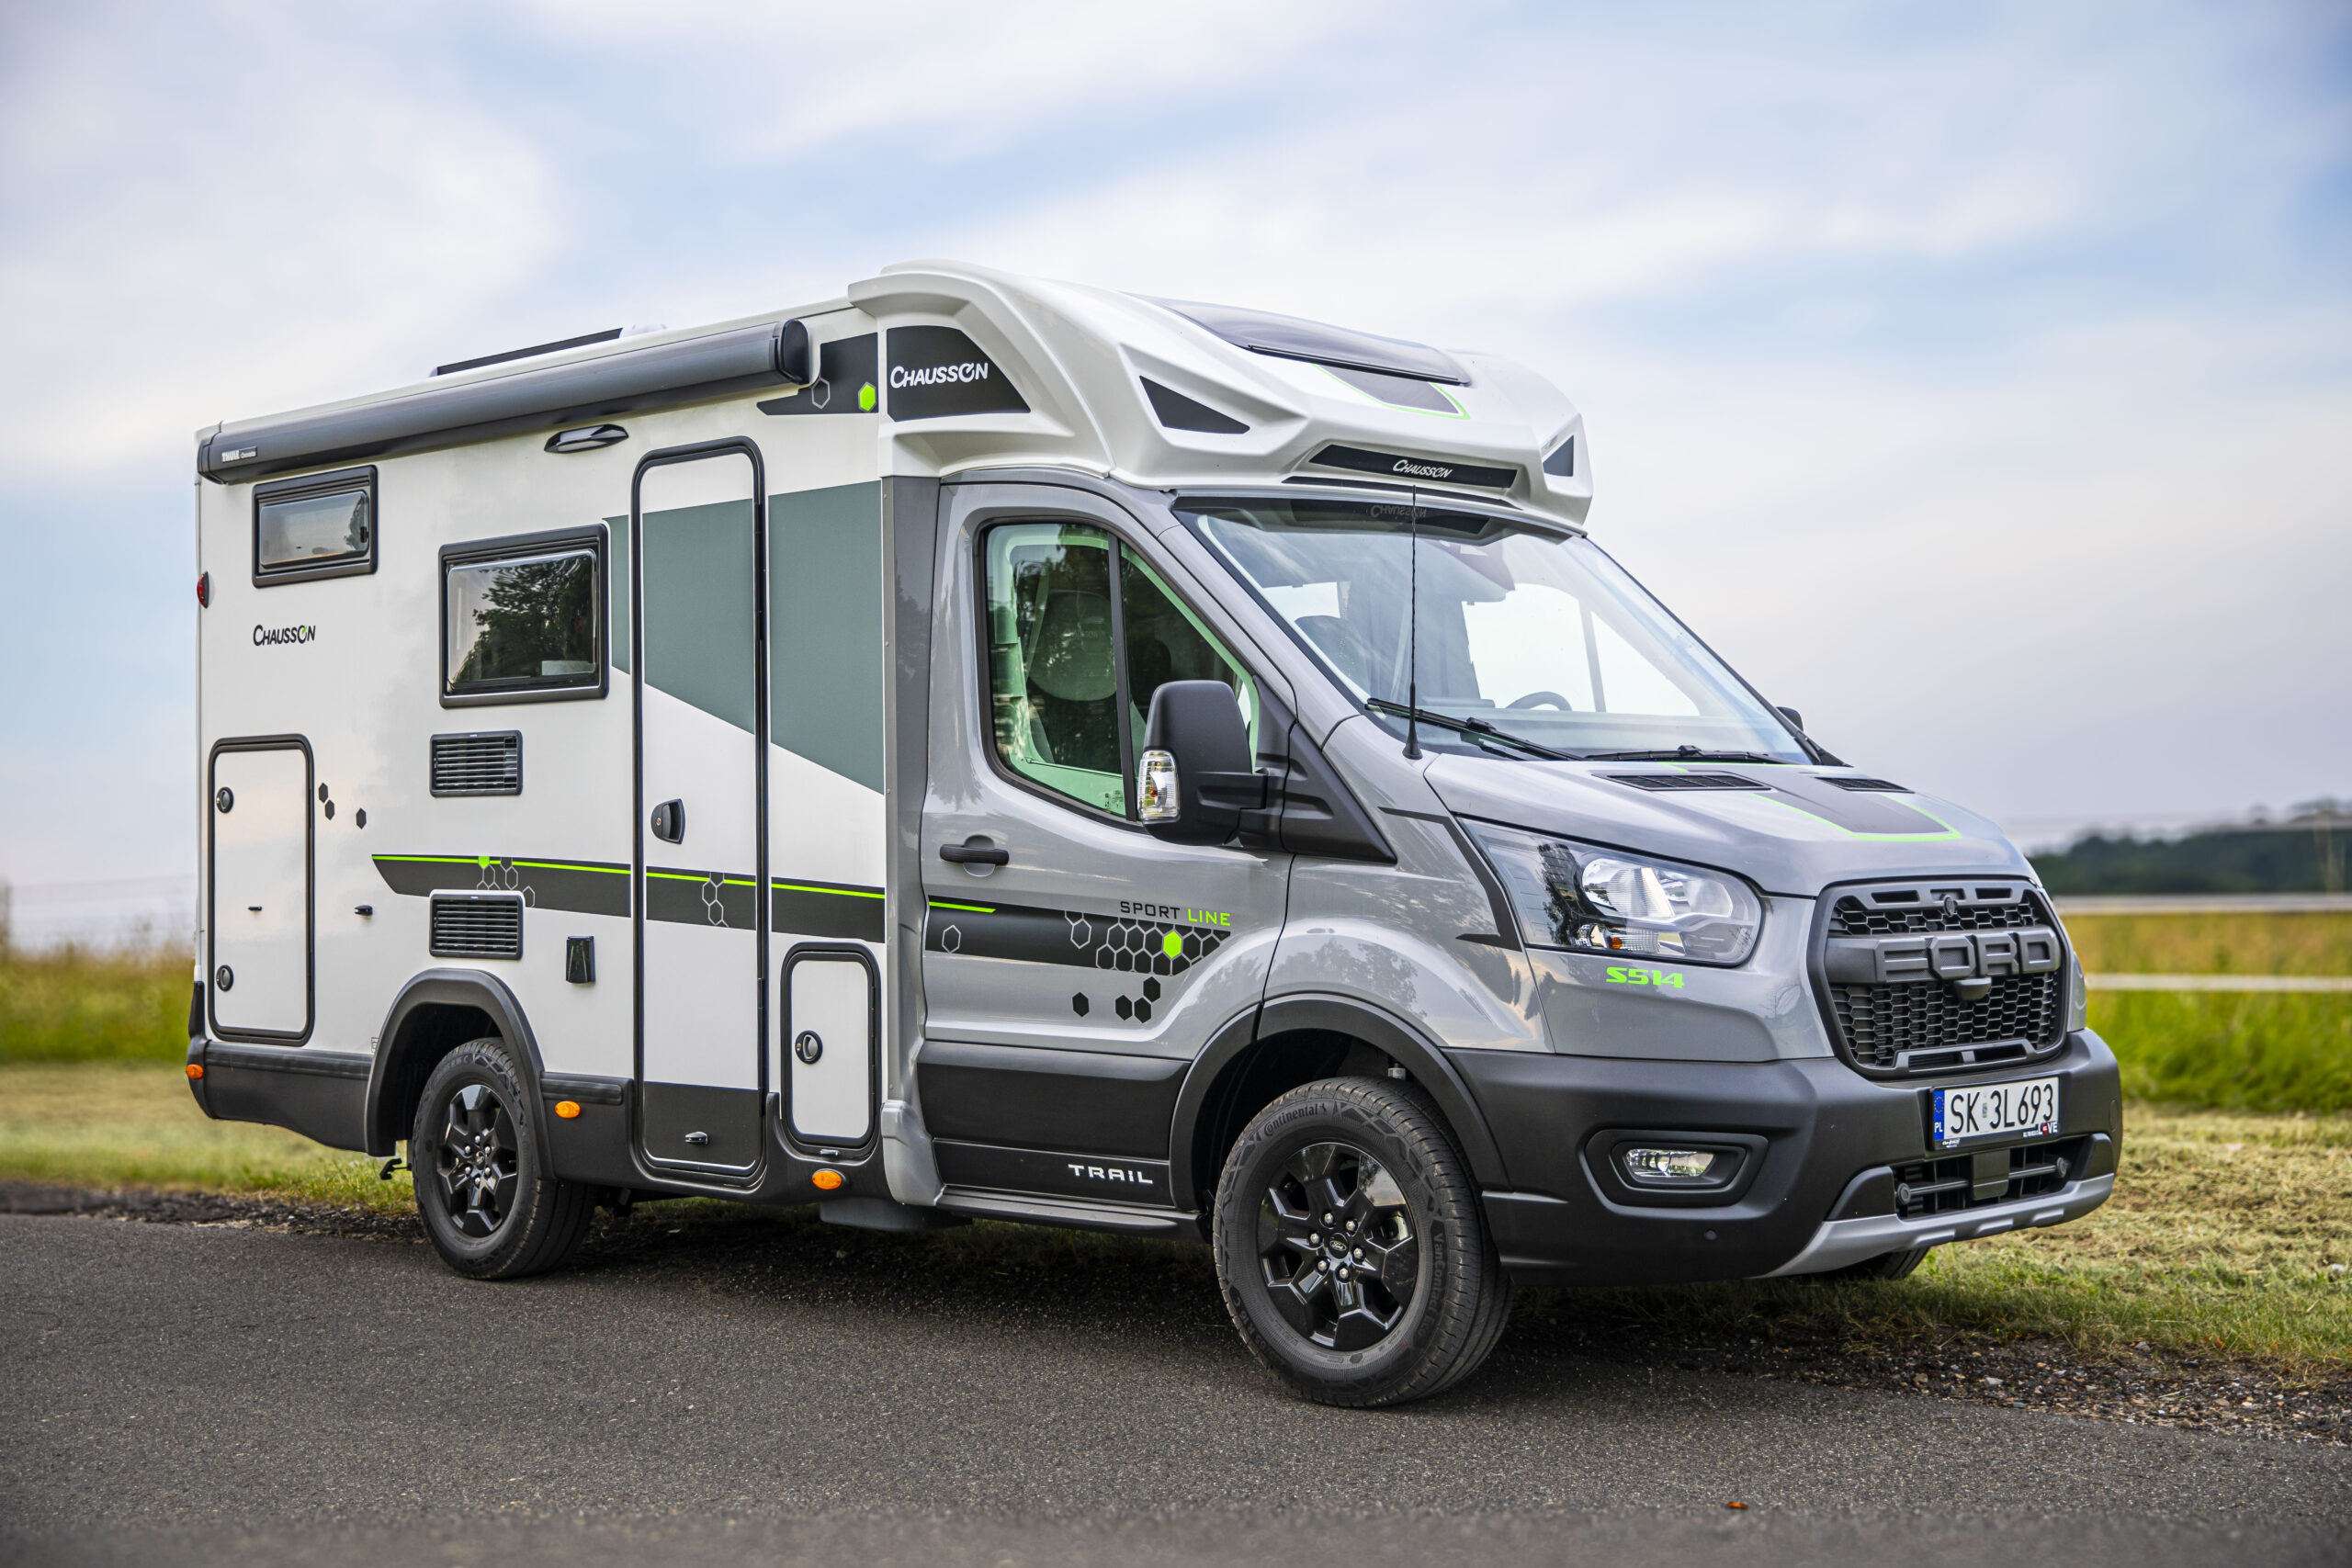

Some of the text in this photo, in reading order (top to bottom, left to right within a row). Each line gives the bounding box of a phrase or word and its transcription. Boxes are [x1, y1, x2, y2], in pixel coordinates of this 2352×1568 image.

[890, 363, 989, 389] CHAUSSON
[1393, 459, 1453, 479] CHAUSSON
[253, 624, 316, 646] CHAUSSON
[1120, 901, 1231, 926] SPORT LINE
[1875, 928, 2061, 982] FORD
[1605, 966, 1684, 988] S514
[1264, 1103, 1317, 1136] Continental
[1951, 1084, 2053, 1134] SK 3L693
[1934, 1122, 1943, 1133] PL
[1068, 1164, 1153, 1184] TRAIL
